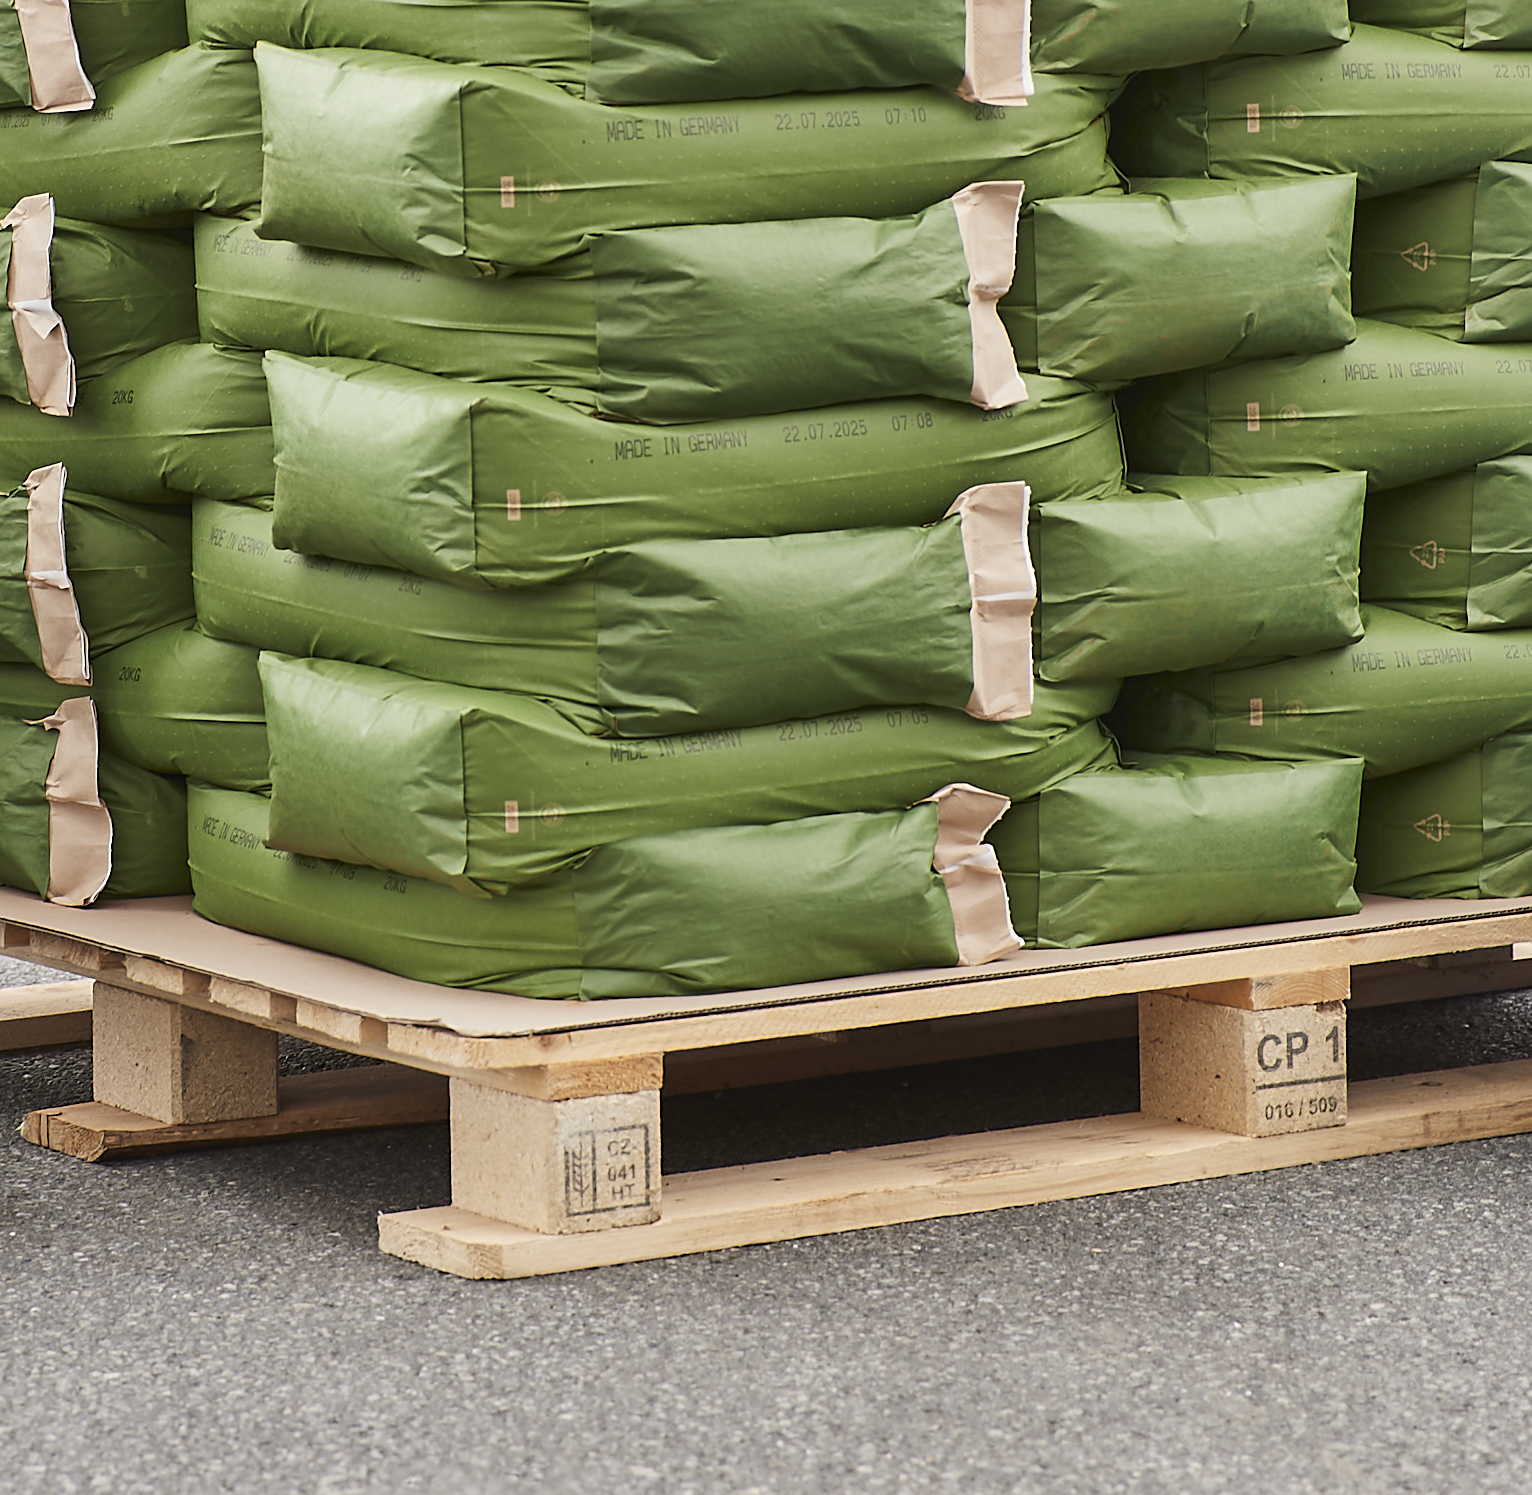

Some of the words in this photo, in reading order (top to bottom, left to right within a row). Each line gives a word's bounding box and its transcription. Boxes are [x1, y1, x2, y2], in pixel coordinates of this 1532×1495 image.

[1341, 63, 1376, 81] MADE
[1385, 62, 1401, 79] IN
[1407, 62, 1463, 79] GERMANY
[93, 106, 114, 122] 20KG
[607, 120, 645, 142] MADE
[656, 118, 672, 139] IN
[680, 115, 741, 137] GERMANY
[775, 110, 861, 131] 22.07.2025
[885, 107, 927, 125] 07:10
[974, 104, 1006, 121] 20KG
[1344, 363, 1379, 381] MADE
[1387, 362, 1403, 379] IN
[1410, 360, 1465, 378] GERMANY
[112, 389, 134, 405] 20KG
[615, 438, 653, 461] MADE
[663, 435, 681, 456] IN
[688, 430, 749, 453] GERMANY
[784, 419, 869, 444] 22.07.2025
[892, 412, 934, 432] 07:08
[1352, 653, 1387, 673] MADE
[1395, 652, 1411, 669] IN
[1418, 646, 1473, 667] GERMANY
[119, 667, 142, 682] 20KG
[610, 741, 648, 764] MADE
[656, 738, 676, 758] IN
[681, 728, 743, 755] GERMANY
[777, 716, 864, 742] 22.07.2025
[887, 709, 929, 729] 07:05
[383, 874, 408, 894] 20KG
[1257, 1031, 1309, 1072] CP
[1325, 1026, 1340, 1063] 1
[1309, 1096, 1338, 1115] 509
[607, 1163, 636, 1182] 041
[611, 1183, 636, 1201] HT
